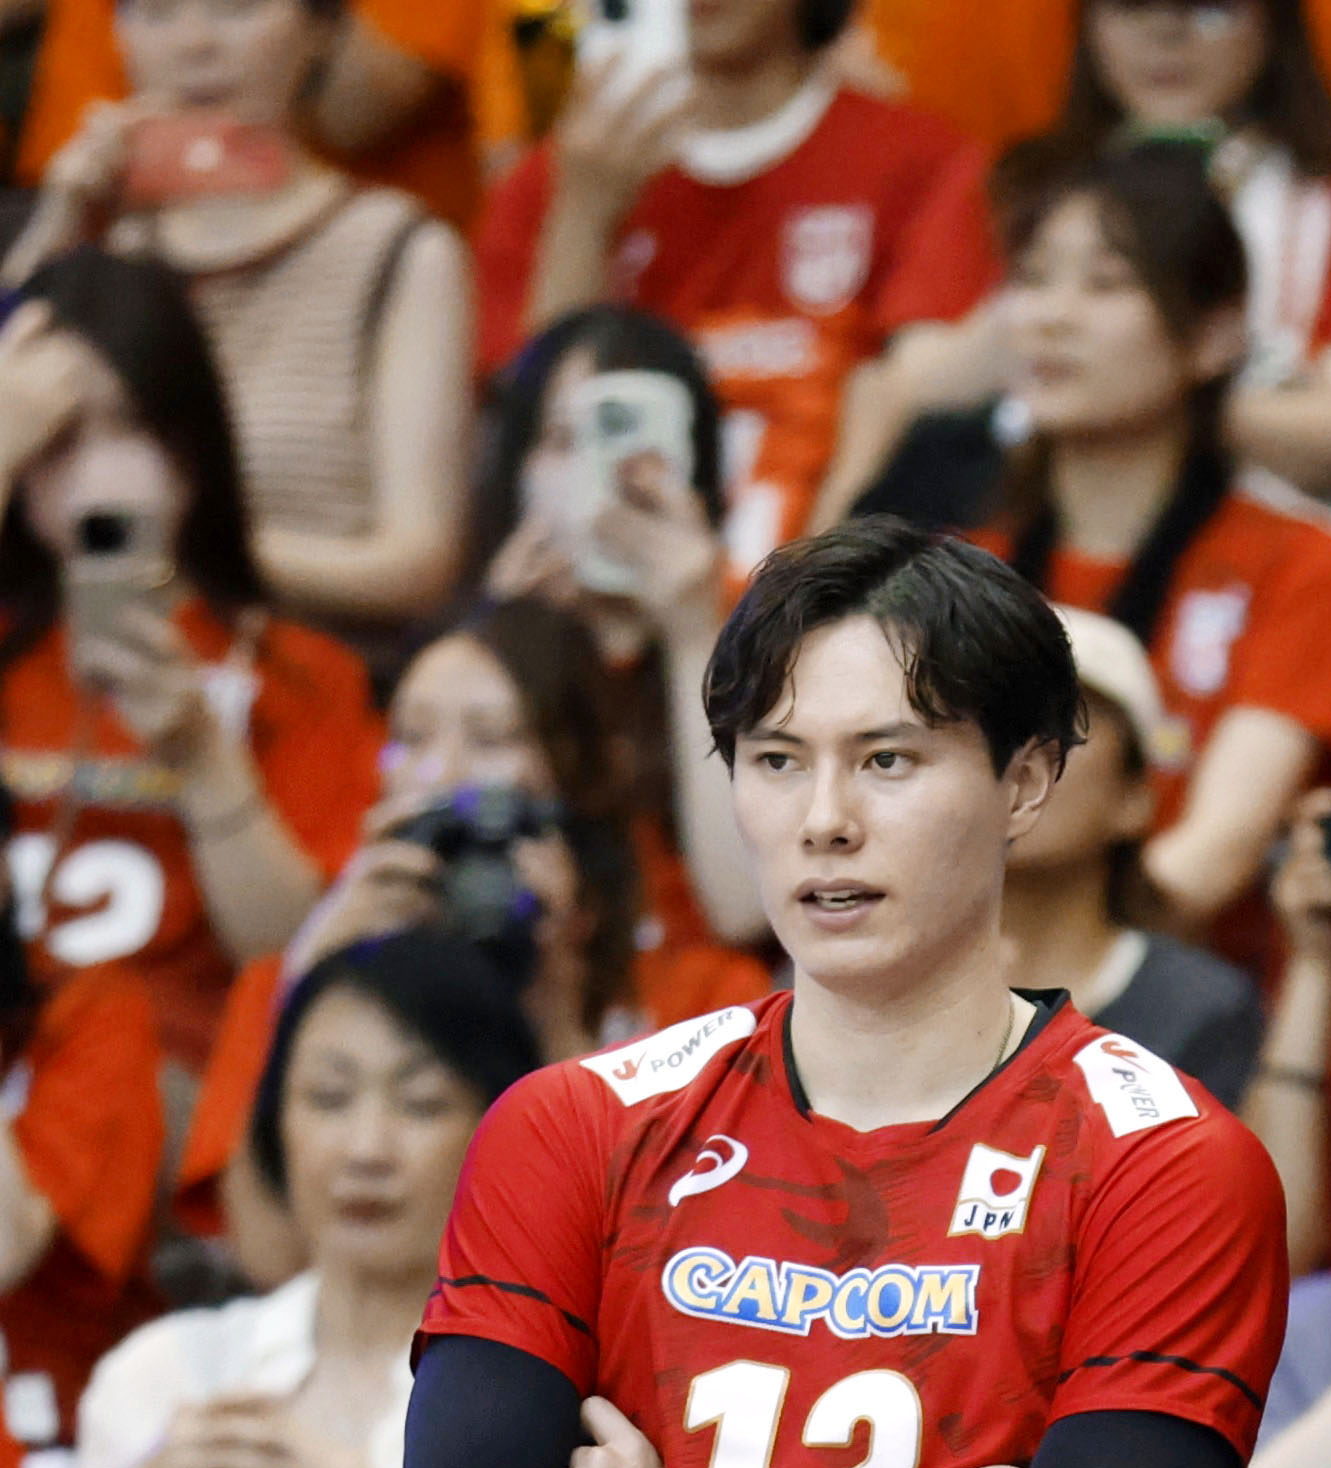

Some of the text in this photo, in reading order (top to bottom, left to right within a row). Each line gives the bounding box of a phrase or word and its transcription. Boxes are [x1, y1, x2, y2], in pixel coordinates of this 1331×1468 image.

[650, 1010, 733, 1073] POWER
[964, 1204, 1014, 1232] JPN
[661, 1246, 981, 1340] CAPCOM
